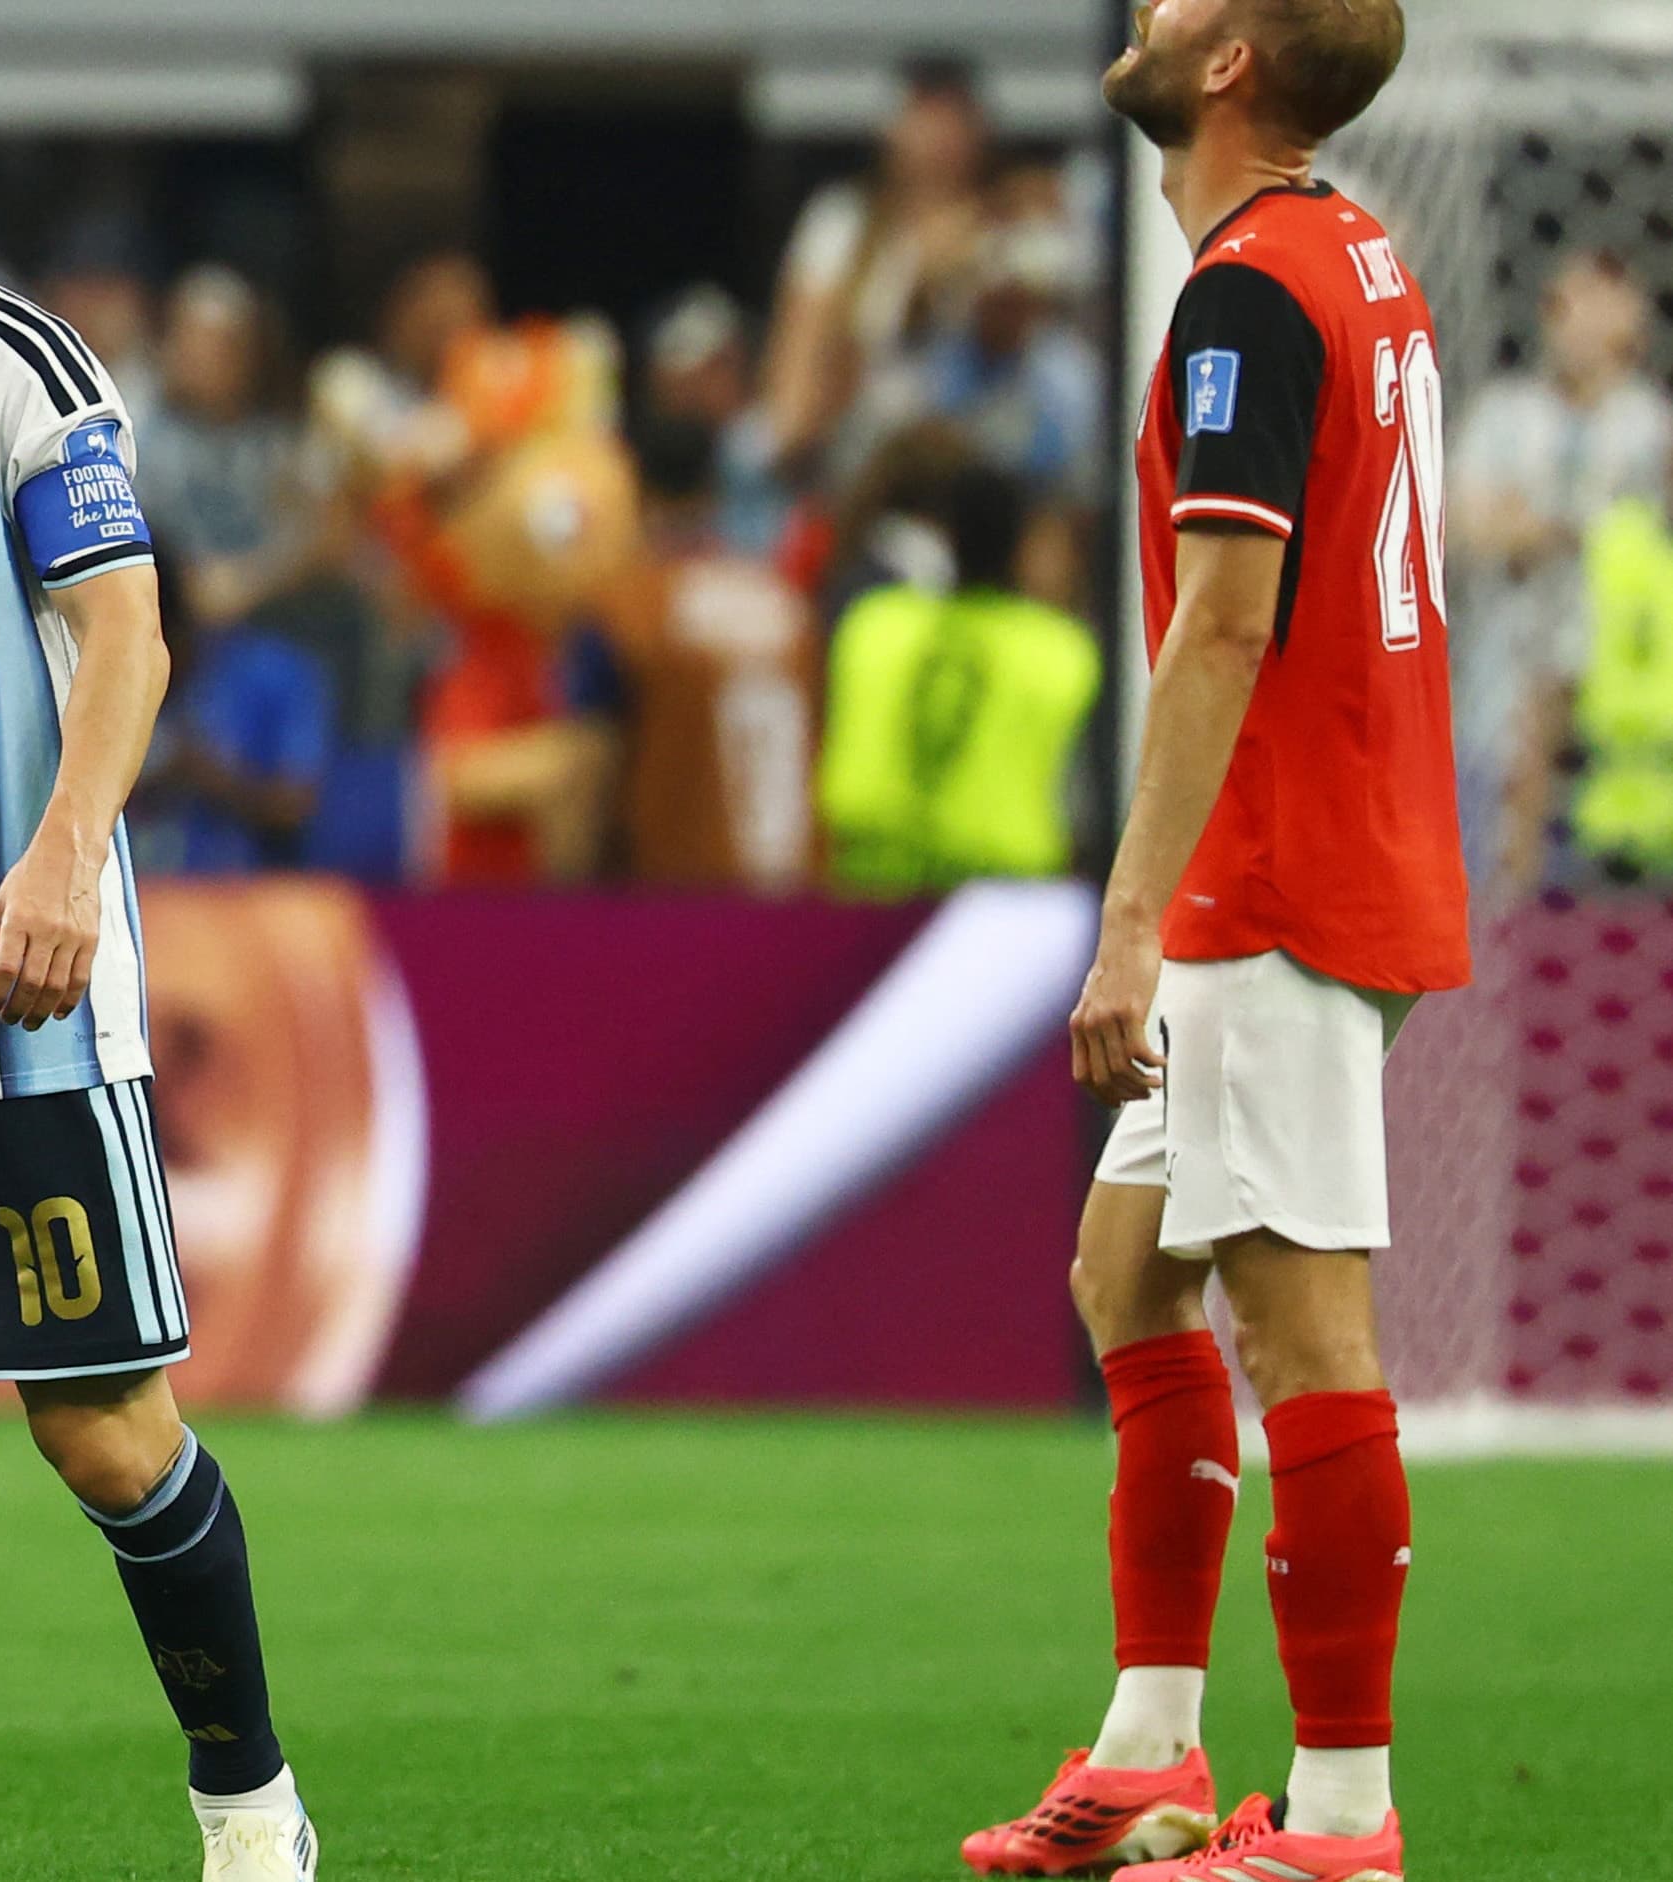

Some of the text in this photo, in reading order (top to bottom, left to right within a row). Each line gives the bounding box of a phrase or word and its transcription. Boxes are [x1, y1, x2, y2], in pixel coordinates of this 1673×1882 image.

[1373, 329, 1447, 652] 20
[68, 507, 103, 529] the
[102, 523, 133, 537] FIFA
